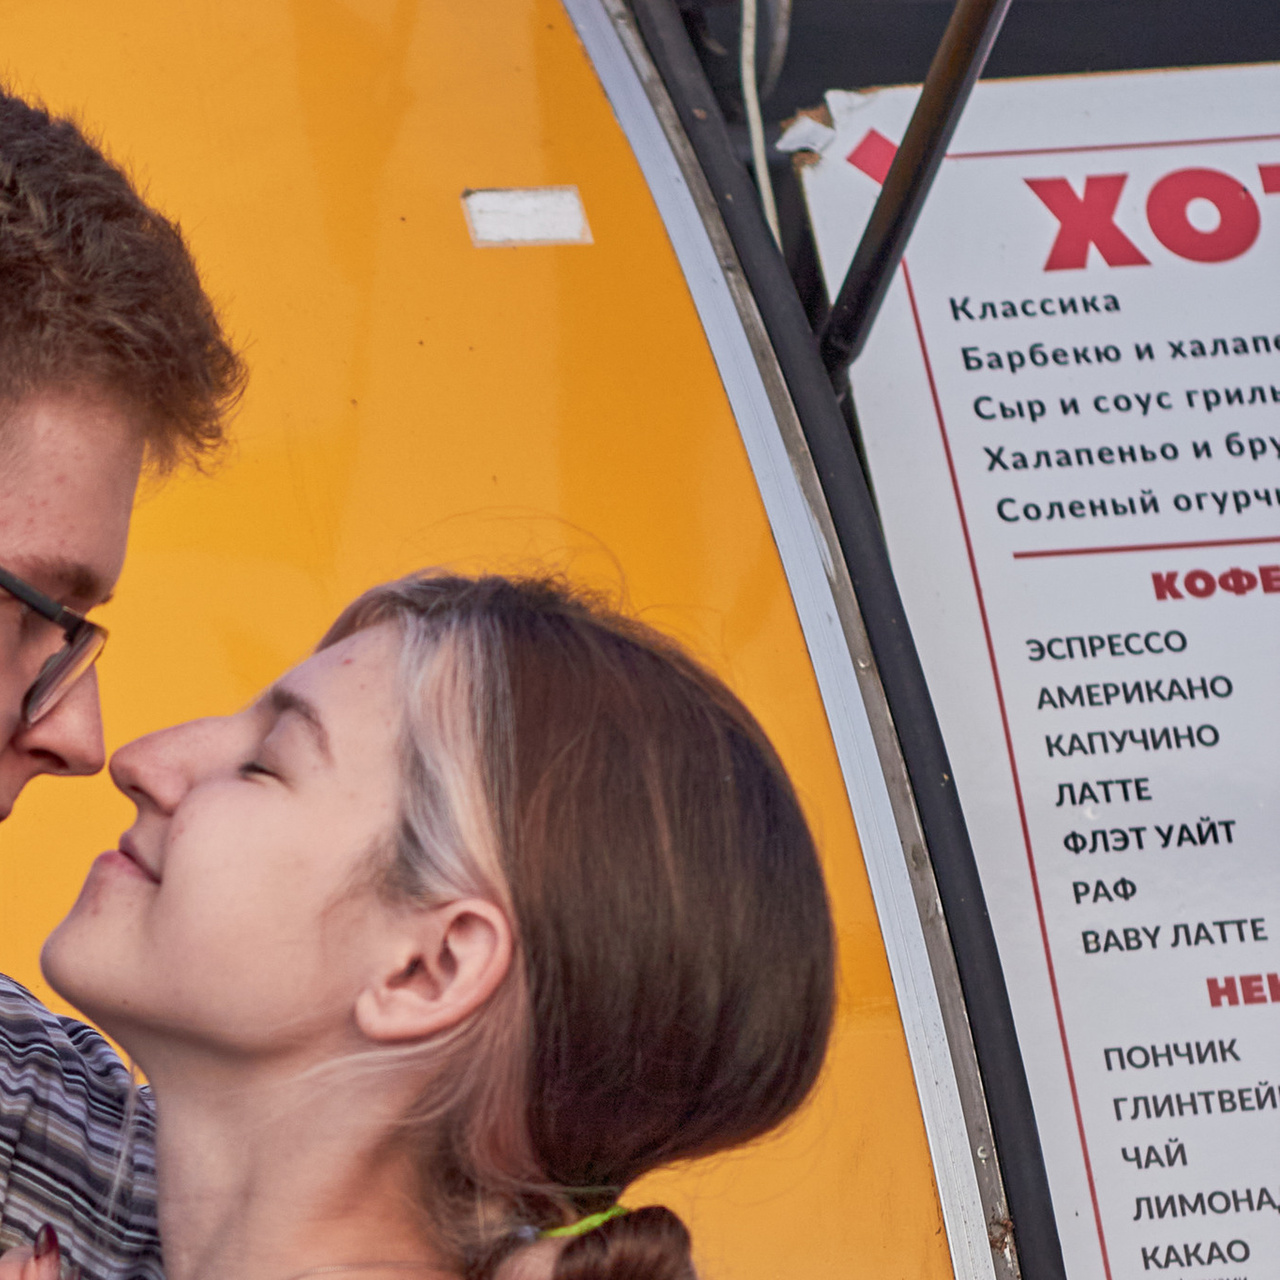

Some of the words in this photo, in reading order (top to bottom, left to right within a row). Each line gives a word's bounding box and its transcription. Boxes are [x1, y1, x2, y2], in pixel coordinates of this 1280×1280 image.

[1024, 163, 1280, 272] ХО
[950, 295, 1120, 321] Классика
[962, 343, 1121, 373] Барбекю
[1135, 343, 1154, 360] и
[974, 396, 1046, 422] Сыр
[1060, 398, 1079, 415] и
[1094, 392, 1172, 416] соус
[1186, 386, 1280, 412] гриль
[984, 443, 1178, 471] Халапеньо
[1193, 441, 1212, 458] и
[997, 490, 1159, 522] Соленый
[1174, 489, 1280, 515] огурч
[1152, 565, 1280, 600] КОФЕ
[1026, 631, 1187, 661] ЭСПРЕССО
[1038, 676, 1233, 709] АМЕРИКАНО
[1046, 724, 1219, 757] КАПУЧИНО
[1056, 778, 1152, 807] ЛАТТЕ
[1064, 827, 1146, 854] ФЛЭТ
[1155, 817, 1235, 848] УАЙТ
[1073, 878, 1136, 904] РАФ
[1082, 926, 1160, 954] BABY
[1171, 918, 1268, 947] ЛАТТЕ
[1104, 1039, 1240, 1071] ПОНЧИК
[1113, 1081, 1280, 1121] ГЛИНТВЕЙ
[1121, 1138, 1187, 1169] ЧАЙ
[1133, 1187, 1280, 1221] ЛИМОНА
[1141, 1240, 1250, 1270] КАКАО
